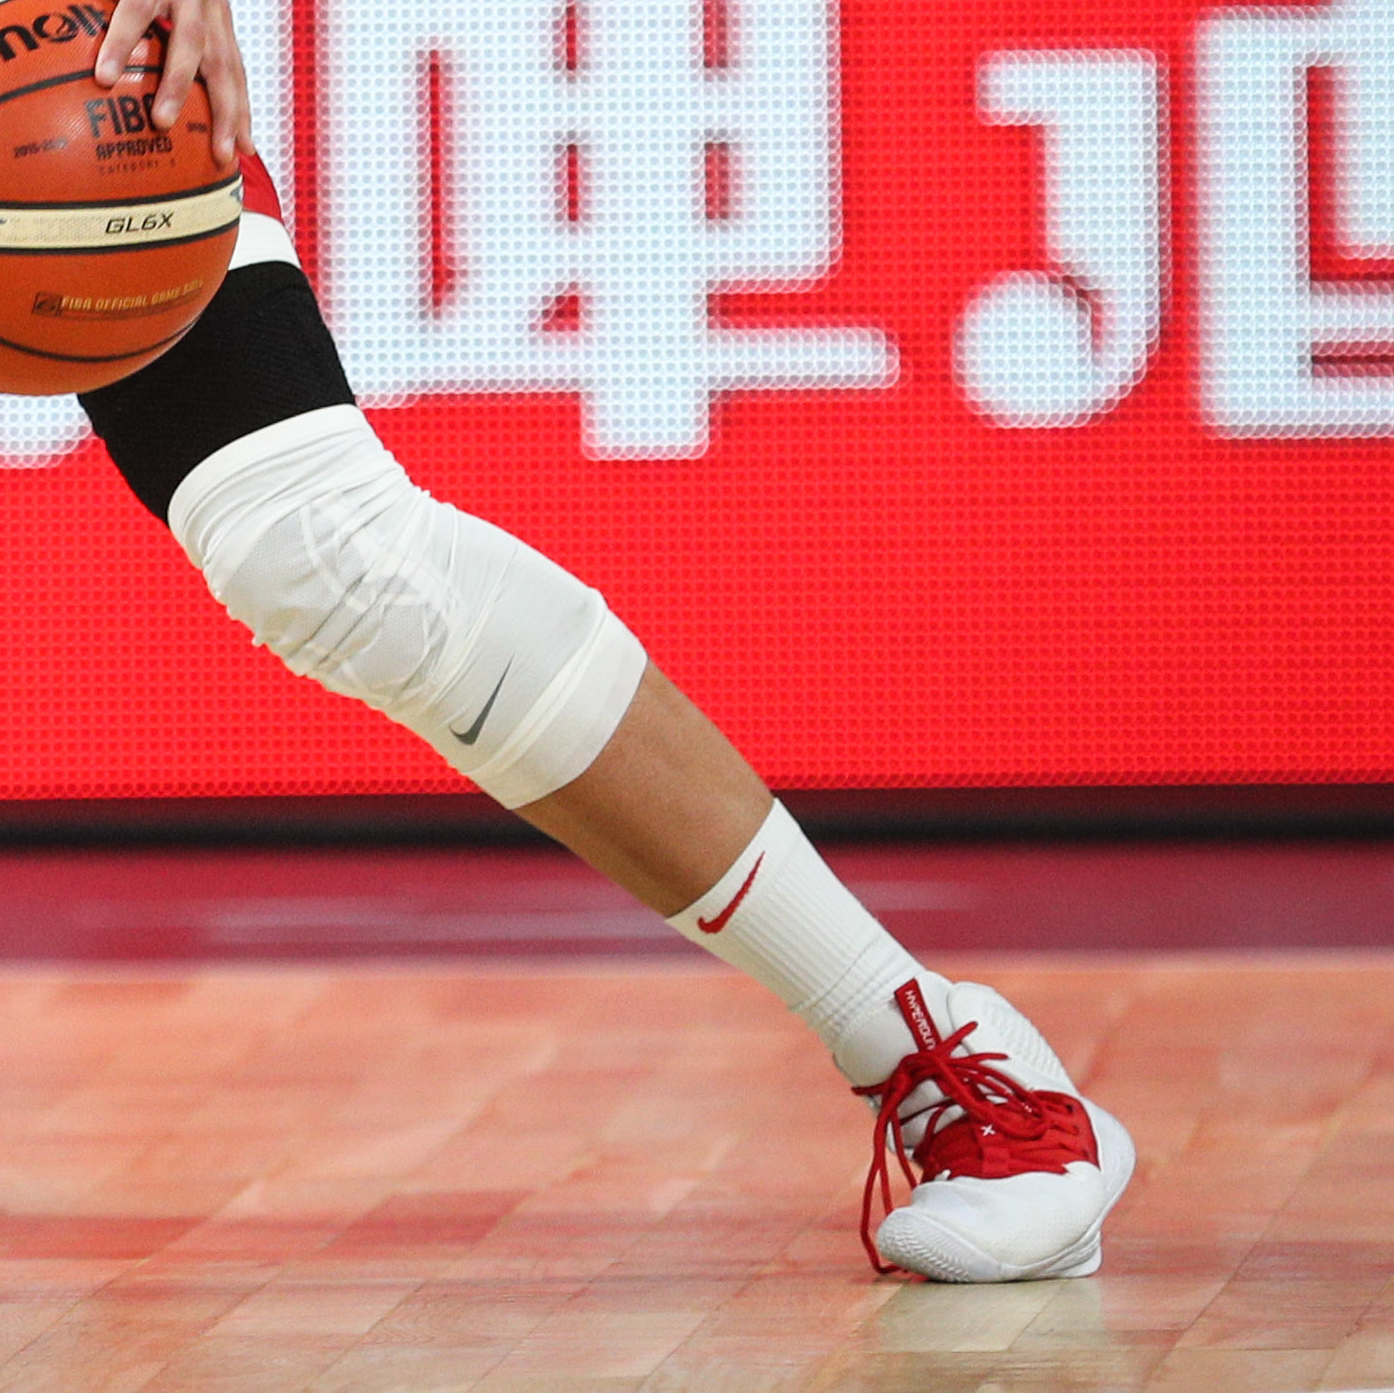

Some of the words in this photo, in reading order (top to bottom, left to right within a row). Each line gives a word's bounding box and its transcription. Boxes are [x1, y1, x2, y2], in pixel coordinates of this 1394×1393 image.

[96, 135, 173, 161] APPROVED
[105, 211, 174, 234] GL6X
[62, 295, 92, 311] FIBA
[95, 295, 148, 312] OFFICIAL
[905, 990, 936, 1051] HYPERDUN
